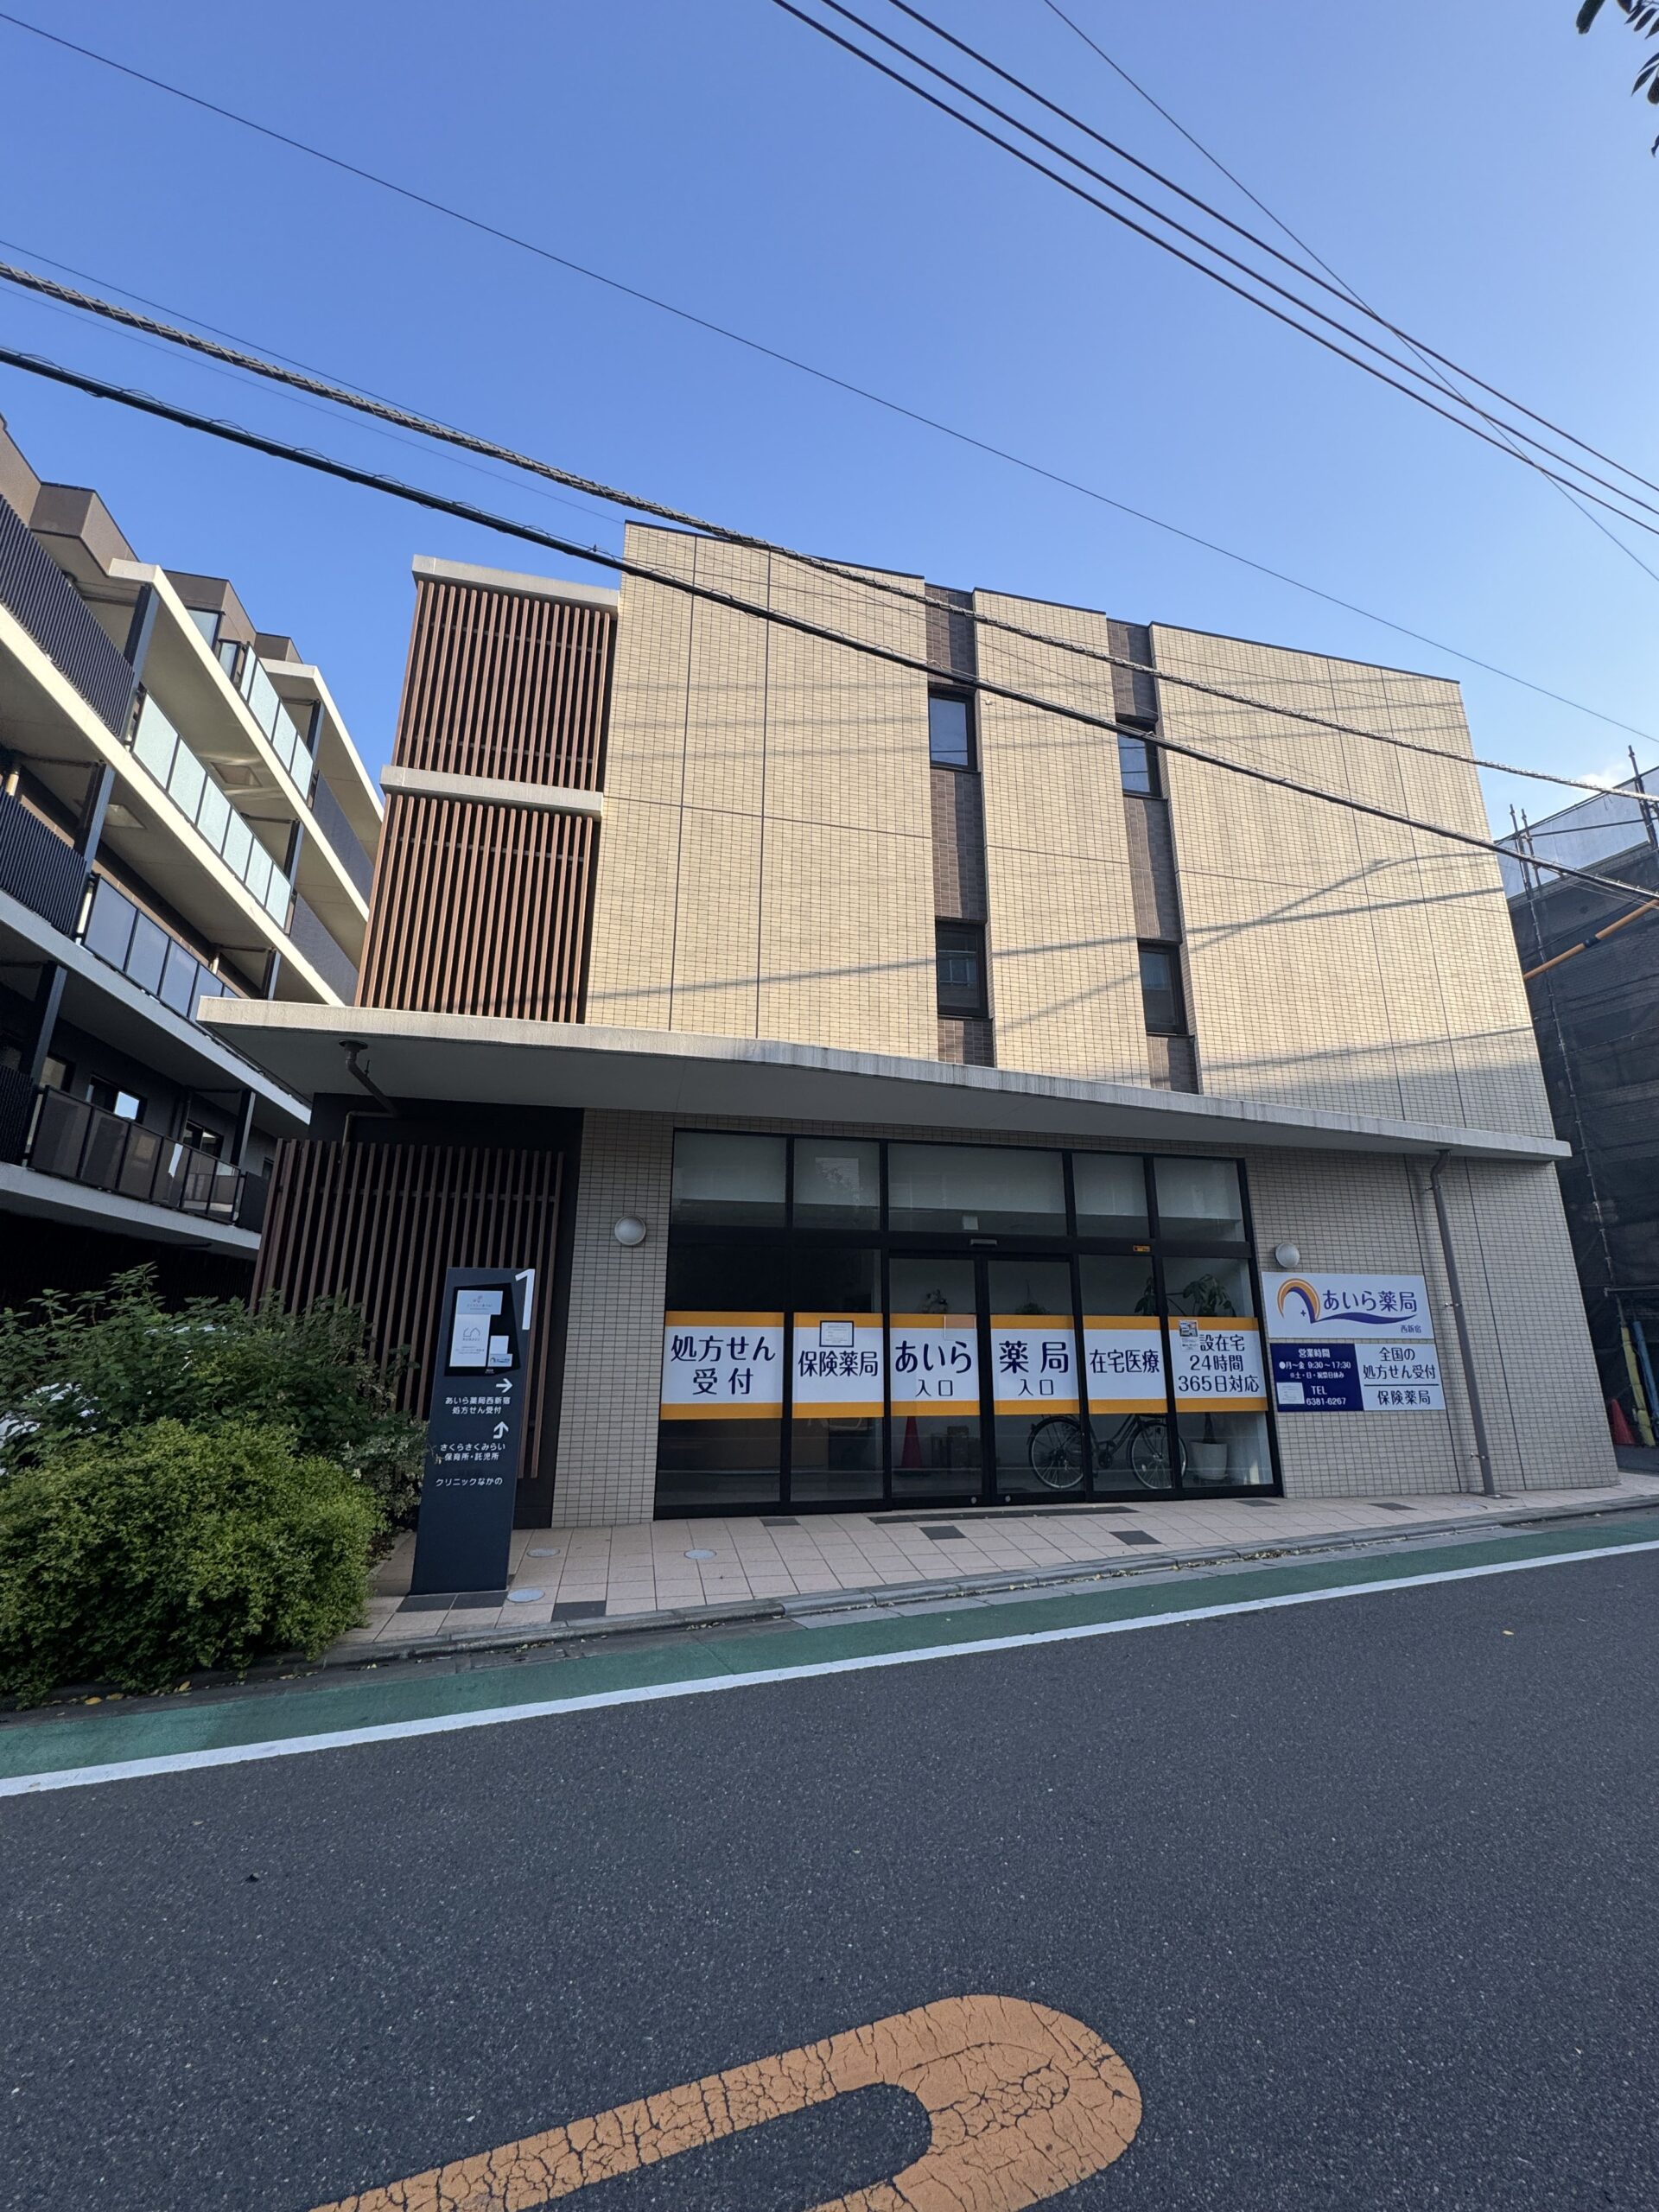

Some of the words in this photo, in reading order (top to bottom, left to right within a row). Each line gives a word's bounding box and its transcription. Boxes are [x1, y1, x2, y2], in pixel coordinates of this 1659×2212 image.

[515, 1268, 535, 1330] 1
[1322, 1290, 1418, 1312] あいら薬局
[1401, 1325, 1421, 1334] 西新宿
[671, 1334, 776, 1362] 処方せん
[1199, 1334, 1245, 1351] 設在宅
[895, 1340, 972, 1374] あいら
[999, 1340, 1070, 1374] 薬局
[1090, 1349, 1160, 1374] 在宅医療
[1298, 1348, 1331, 1358] 営業時間
[1380, 1347, 1415, 1361] 全国の
[798, 1351, 879, 1376] 保険薬局
[1189, 1355, 1244, 1372] 24時間
[1363, 1364, 1436, 1380] 処方せん受付
[692, 1368, 753, 1395] 受付
[916, 1379, 954, 1397] 入口
[1018, 1378, 1054, 1396] 入口
[1178, 1375, 1260, 1392] 365日対応
[1311, 1385, 1327, 1395] TEL
[445, 1396, 511, 1405] あいら薬局西新宿
[1377, 1390, 1431, 1406] 保険薬局
[452, 1406, 502, 1414] 処方せん受付
[440, 1443, 505, 1452] さくらさくみらい
[435, 1477, 503, 1487] クリニックなかの
